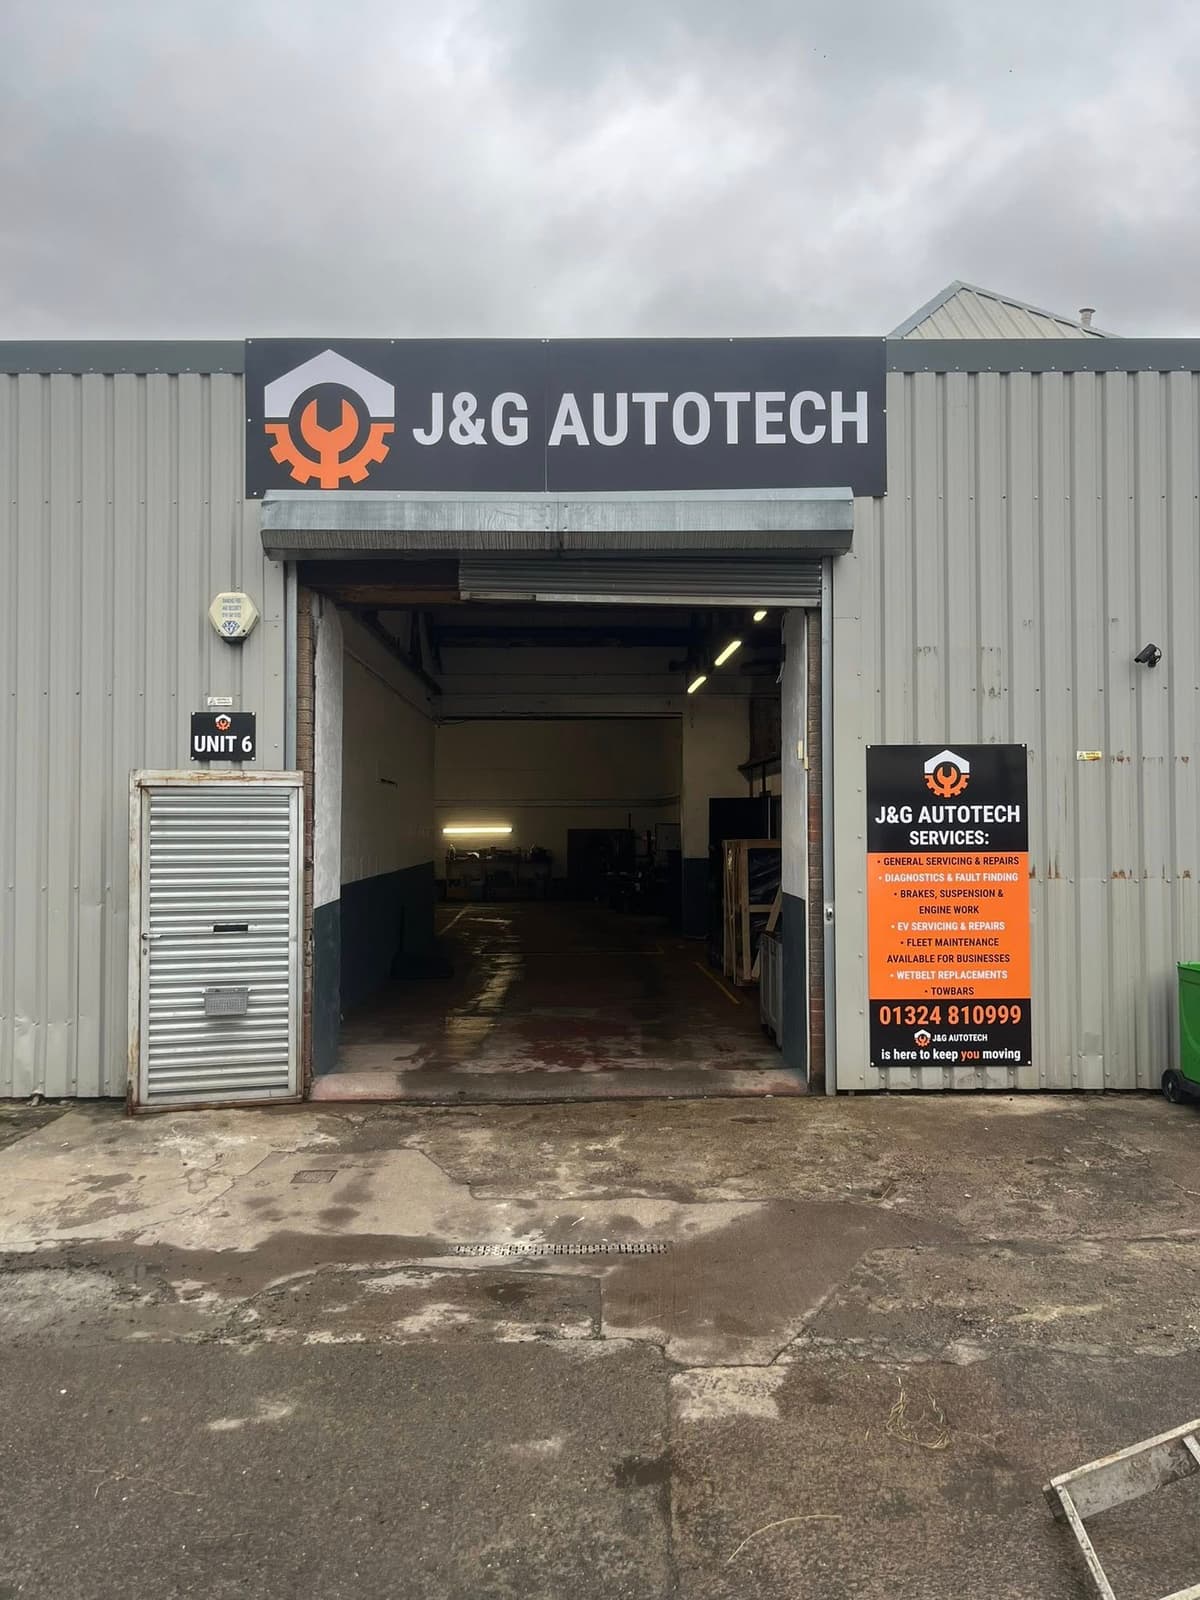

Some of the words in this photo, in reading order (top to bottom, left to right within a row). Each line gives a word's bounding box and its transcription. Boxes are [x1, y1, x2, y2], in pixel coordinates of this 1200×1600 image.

[412, 391, 528, 446] J&G
[548, 389, 869, 446] AUTOTECH
[194, 735, 237, 752] UNIT
[241, 735, 253, 752] 6
[875, 806, 913, 823] J&G
[918, 805, 1020, 823] AUTOTECH
[909, 830, 989, 845] SERVICES:
[883, 857, 923, 866] GENERAL
[926, 857, 972, 865] SERVICING
[975, 857, 980, 865] &
[983, 856, 1019, 865] REPAIRS
[885, 873, 944, 882] DIAGNOSTICS
[947, 873, 953, 882] &
[955, 873, 980, 882] FAULT
[983, 872, 1018, 881] FINDING
[900, 890, 937, 899] BRAKES,
[940, 889, 995, 898] SUSPENSION
[997, 889, 1004, 897] &
[919, 906, 951, 914] ENGINE
[954, 905, 979, 914] WORK
[897, 922, 909, 931] EV
[911, 922, 958, 930] SERVICING
[960, 922, 966, 930] &
[968, 921, 1005, 930] REPAIRS
[906, 938, 933, 947] FLEET
[935, 938, 999, 946] MAINTENANCE
[887, 955, 934, 963] AVAILABLE
[937, 955, 954, 963] FOR
[956, 954, 1010, 963] BUSINESSES
[896, 971, 935, 980] WETBELT
[938, 970, 1008, 979] REPLACEMENTS
[932, 987, 974, 995] TOWBARS
[879, 1006, 941, 1025] 01324
[948, 1005, 1022, 1025] 810999
[932, 1034, 947, 1042] J&G
[949, 1033, 988, 1042] AUTOTECH
[881, 1049, 891, 1060] is
[893, 1049, 917, 1060] here
[919, 1050, 930, 1060] to
[933, 1049, 958, 1062] keep
[960, 1050, 980, 1061] you
[982, 1048, 1021, 1061] moving
